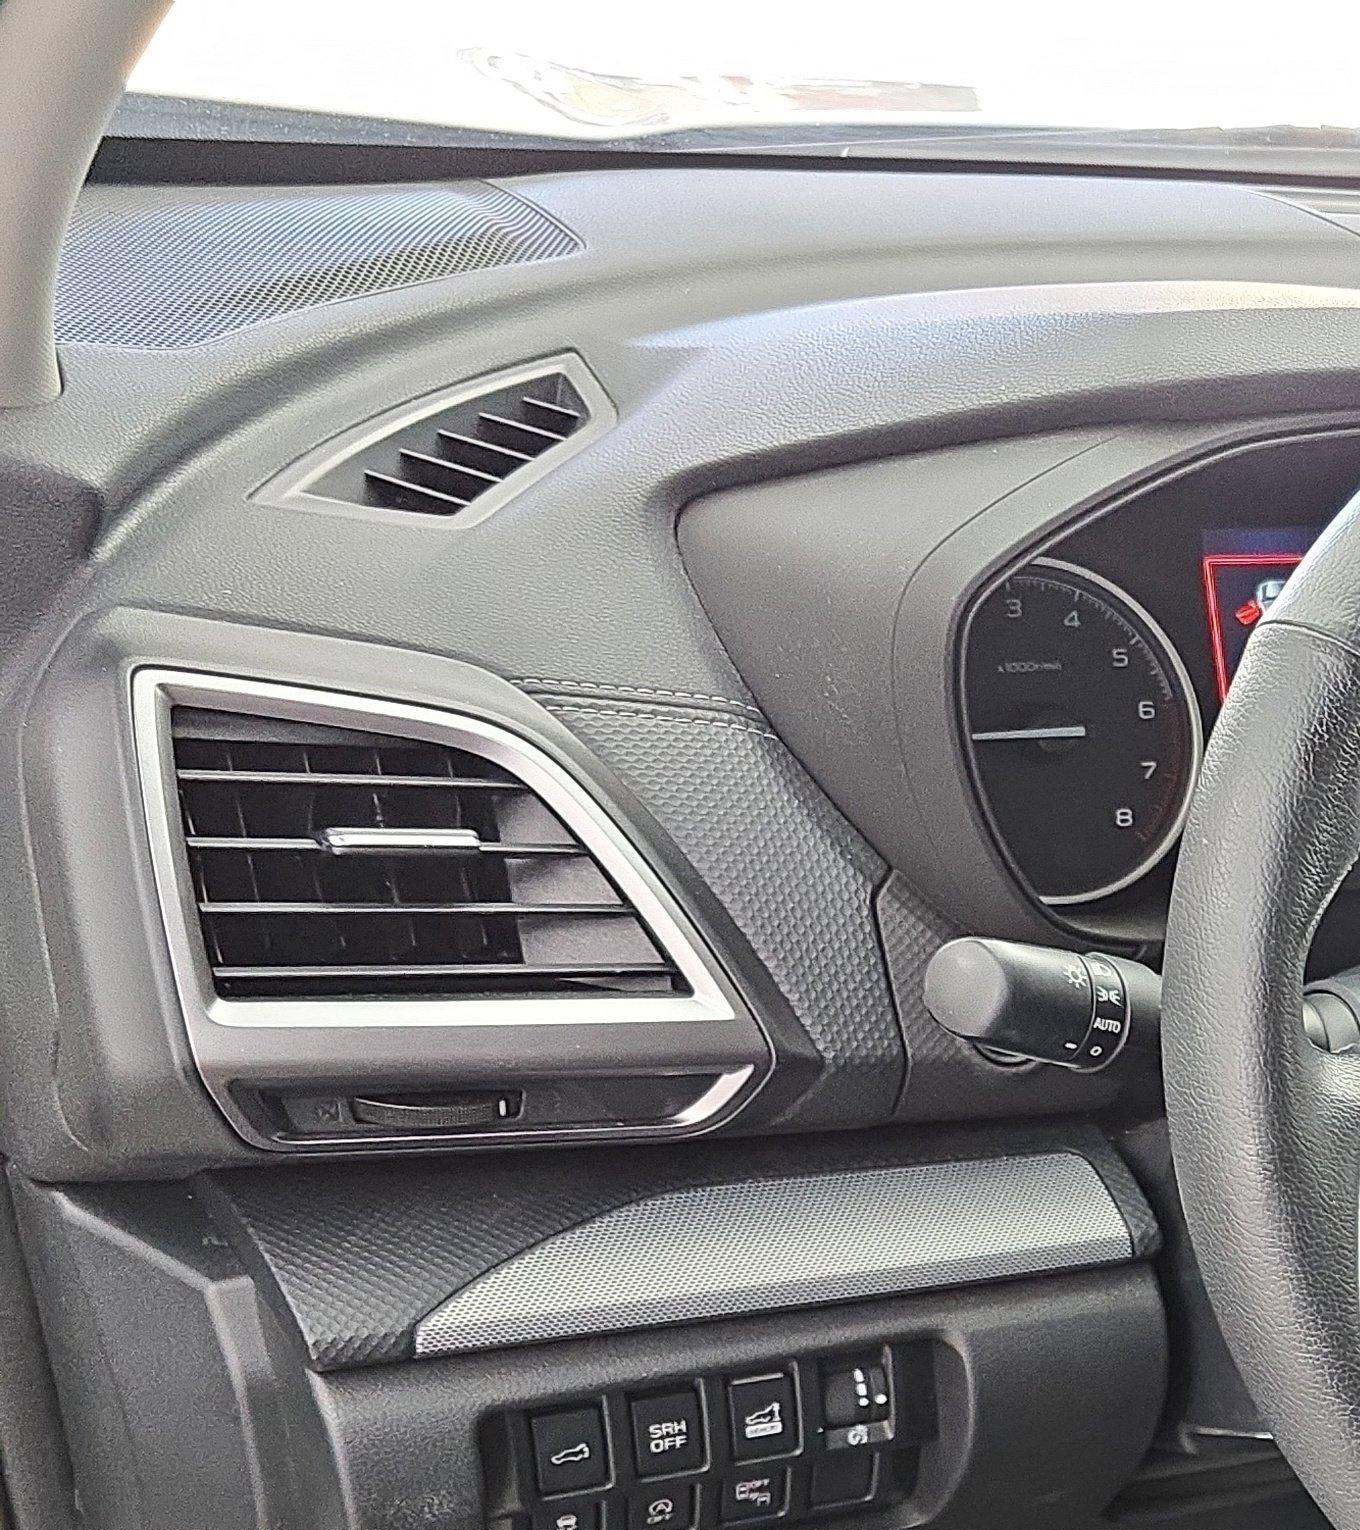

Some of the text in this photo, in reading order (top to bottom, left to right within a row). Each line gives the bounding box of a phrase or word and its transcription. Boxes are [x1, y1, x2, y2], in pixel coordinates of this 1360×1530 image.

[1006, 599, 1023, 618] 3
[1063, 609, 1081, 628] 4
[1112, 648, 1129, 668] 5
[1138, 701, 1156, 720] 6
[1141, 760, 1158, 780] 7
[1115, 808, 1133, 827] 8
[1093, 1016, 1121, 1034] AUTO
[648, 1418, 688, 1439] SRH
[649, 1434, 689, 1454] OFF
